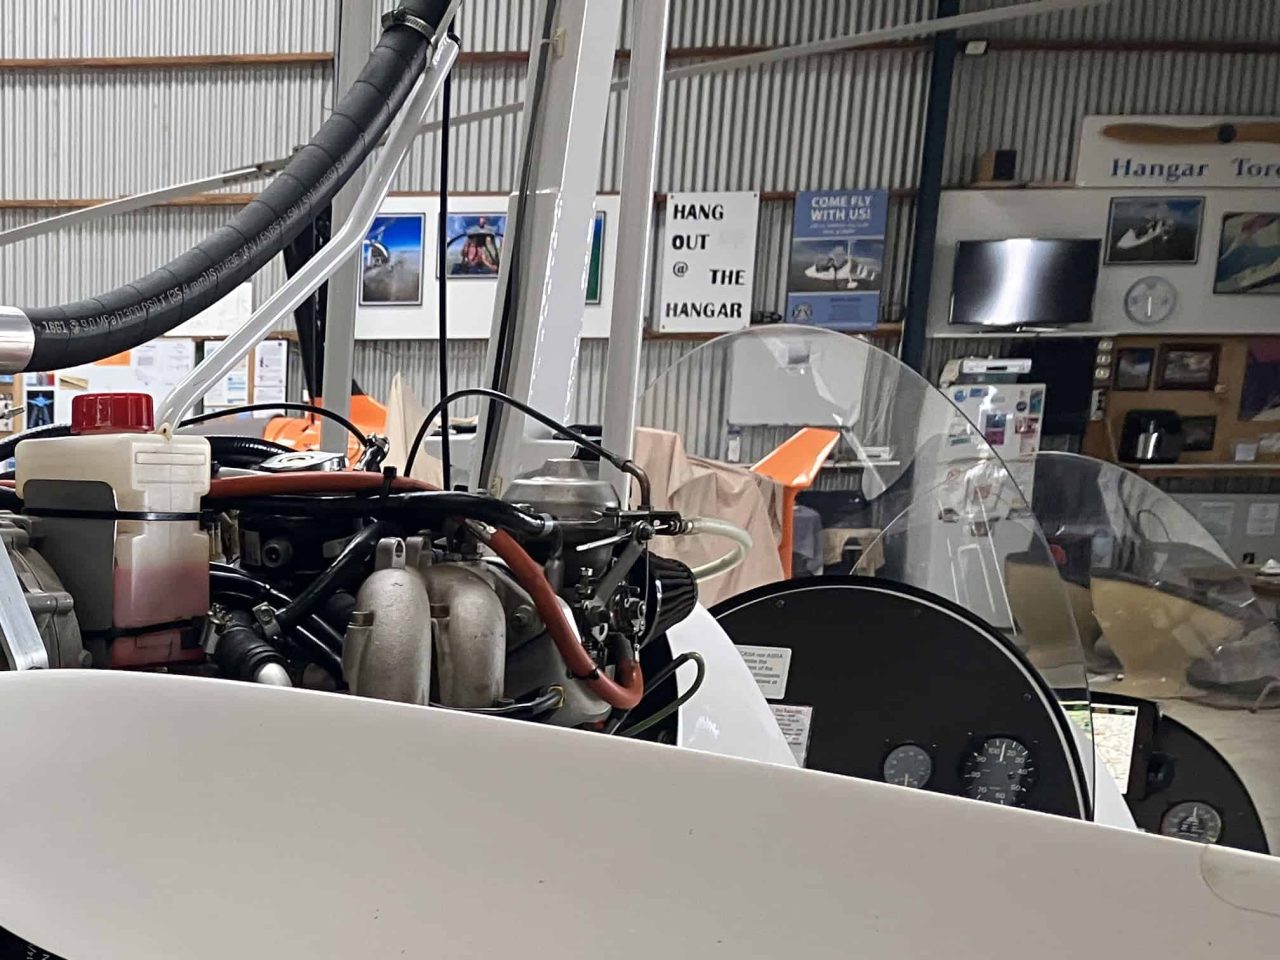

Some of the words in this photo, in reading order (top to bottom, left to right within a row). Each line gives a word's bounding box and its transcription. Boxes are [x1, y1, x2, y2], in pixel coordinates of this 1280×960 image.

[1111, 157, 1209, 183] Hangar
[811, 196, 847, 208] COME
[850, 195, 872, 207] FLY
[673, 203, 724, 221] HANG
[810, 208, 845, 221] WITH
[848, 207, 871, 220] US!
[671, 233, 710, 250] OUT
[672, 261, 688, 278] @
[709, 268, 747, 285] THE
[665, 302, 742, 319] HANGAR
